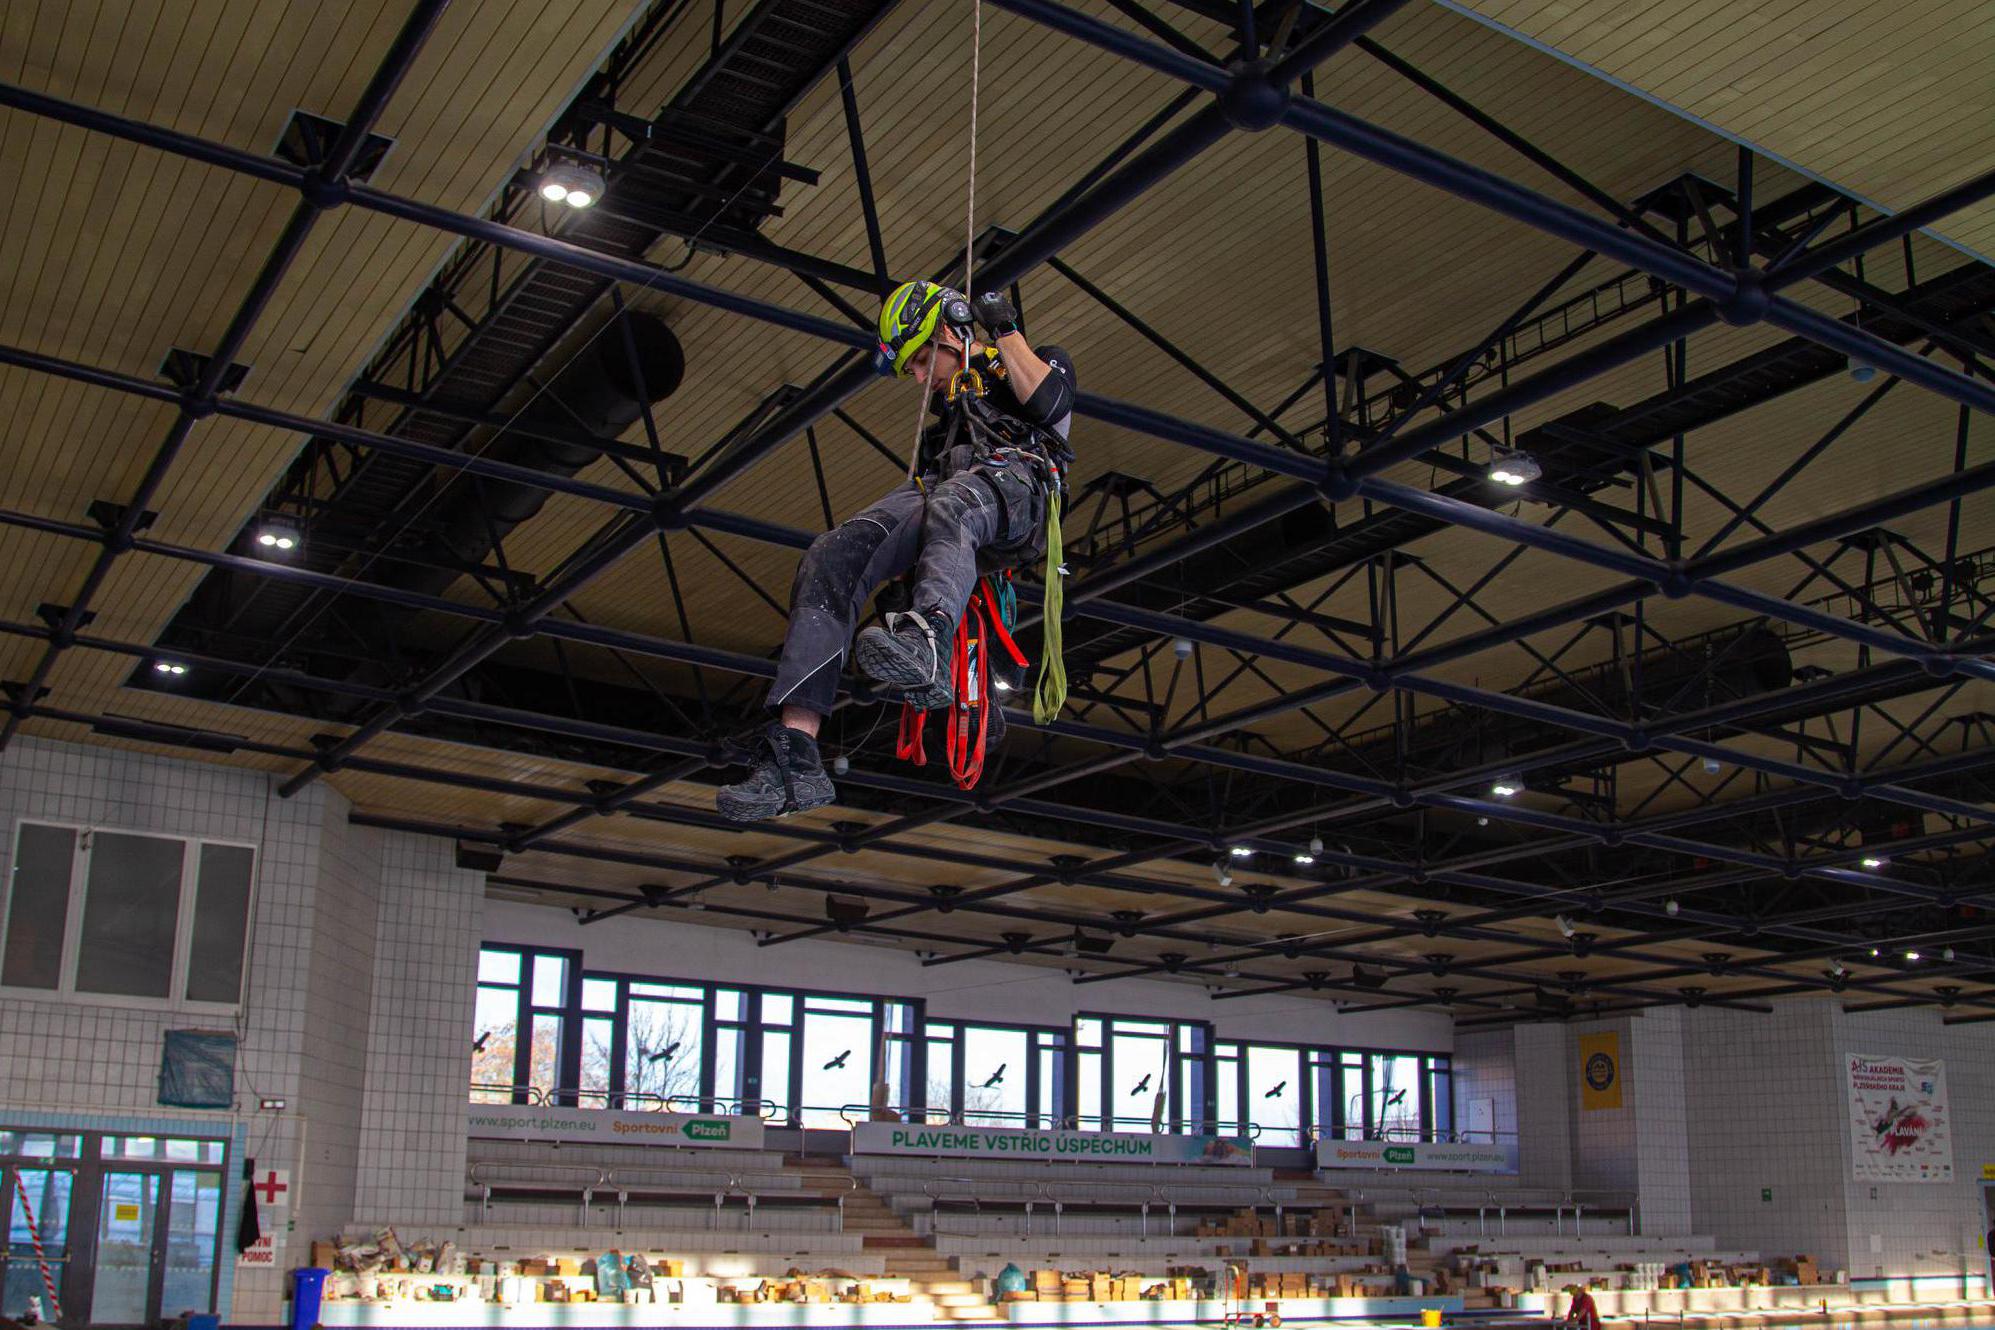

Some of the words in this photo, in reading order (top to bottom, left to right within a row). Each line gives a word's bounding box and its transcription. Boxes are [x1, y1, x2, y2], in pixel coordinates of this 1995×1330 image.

[691, 1123, 727, 1137] Plzeň
[892, 1131, 980, 1150] PLAVEME
[984, 1131, 1050, 1154] VSTŘÍC
[1055, 1134, 1152, 1156] ÚSPĚCHŮM
[1389, 1150, 1413, 1161] Plzeň
[242, 1251, 273, 1263] POMOC
